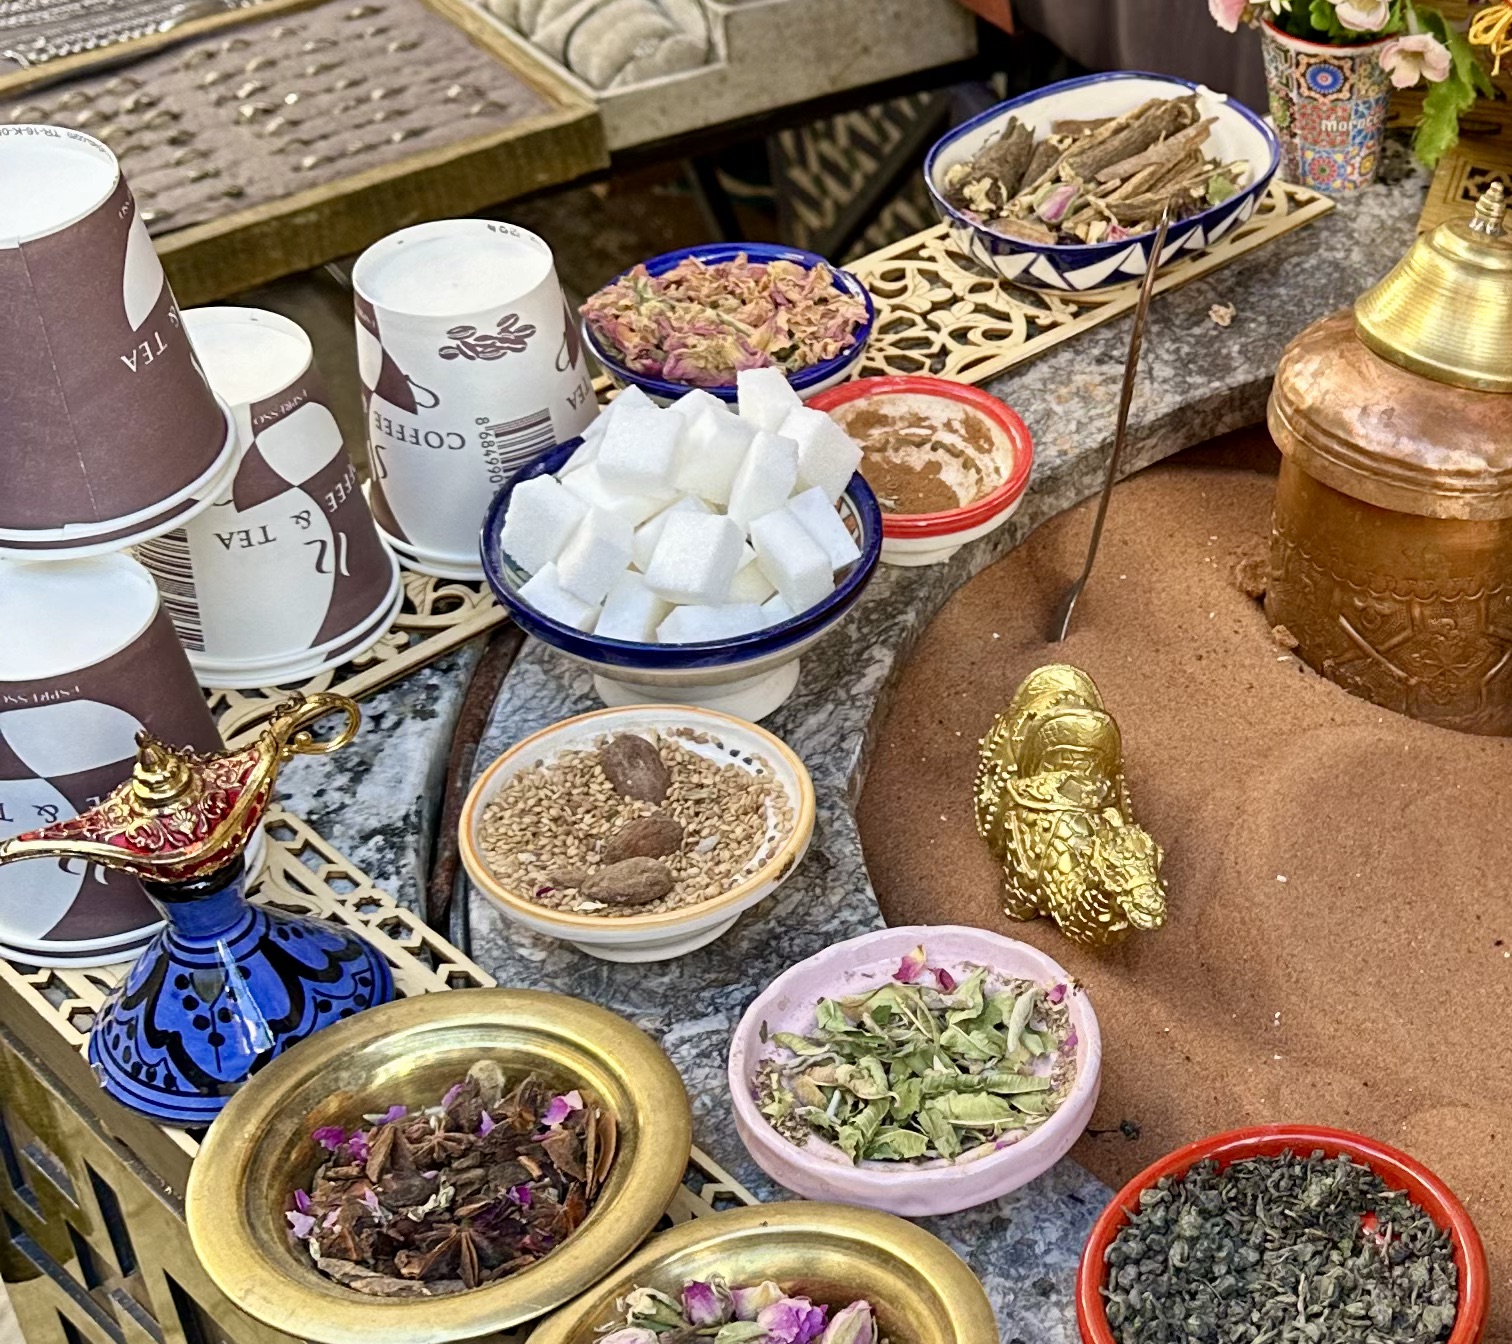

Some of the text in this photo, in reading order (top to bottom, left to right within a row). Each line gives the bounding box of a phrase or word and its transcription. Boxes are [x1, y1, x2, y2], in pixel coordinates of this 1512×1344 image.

[120, 331, 168, 373] TEA
[373, 409, 467, 451] COFFEE
[289, 509, 312, 530] &
[213, 524, 278, 551] TEA
